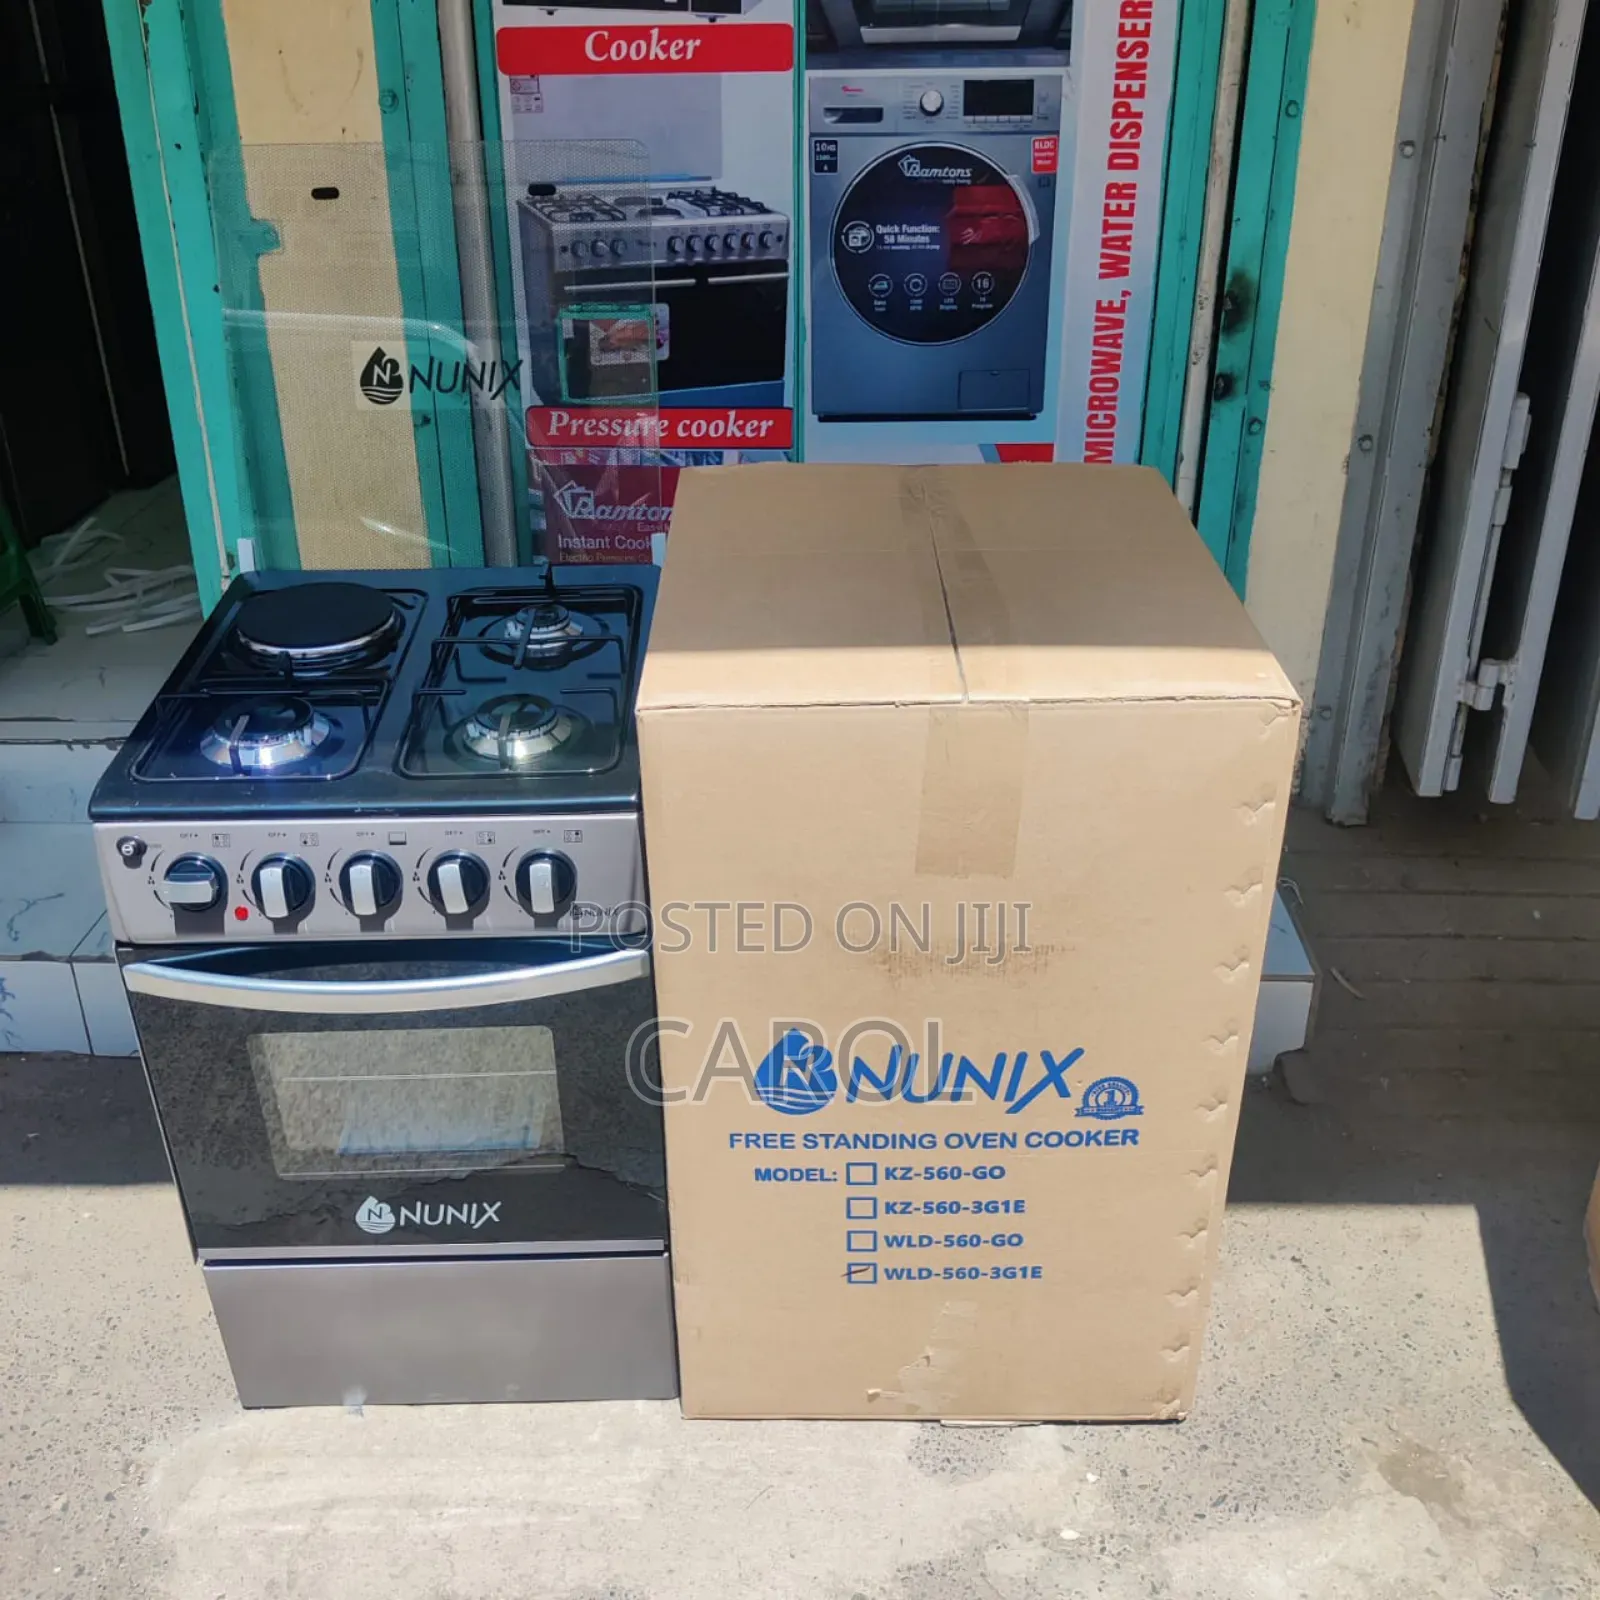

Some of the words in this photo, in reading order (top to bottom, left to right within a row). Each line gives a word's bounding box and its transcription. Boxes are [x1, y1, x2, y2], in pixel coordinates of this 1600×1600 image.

[584, 28, 702, 61] Cooker
[1107, 0, 1155, 170] DISPENSER
[876, 224, 900, 234] Quick
[902, 223, 940, 233] Function:
[1099, 182, 1137, 280] WATER
[409, 355, 523, 400] NUNIX
[1084, 290, 1132, 464] MICROWAVE,
[547, 410, 669, 438] Pressure
[676, 409, 774, 438] cooker
[558, 533, 611, 549] Instant
[846, 1044, 1085, 1114] NUNIX
[729, 1133, 796, 1150] FREE
[803, 1132, 937, 1150] STANDING
[944, 1131, 1018, 1150] OVEN
[1024, 1128, 1140, 1149] COOKER
[754, 1167, 838, 1182] MODEL:
[884, 1165, 1006, 1181] KZ-560-GO
[400, 1201, 501, 1229] NUNIX
[884, 1199, 1026, 1216] KZ-560-3G1E
[884, 1232, 1024, 1248] WLD-560-GO
[884, 1265, 1043, 1281] WLD-560-3G1E
